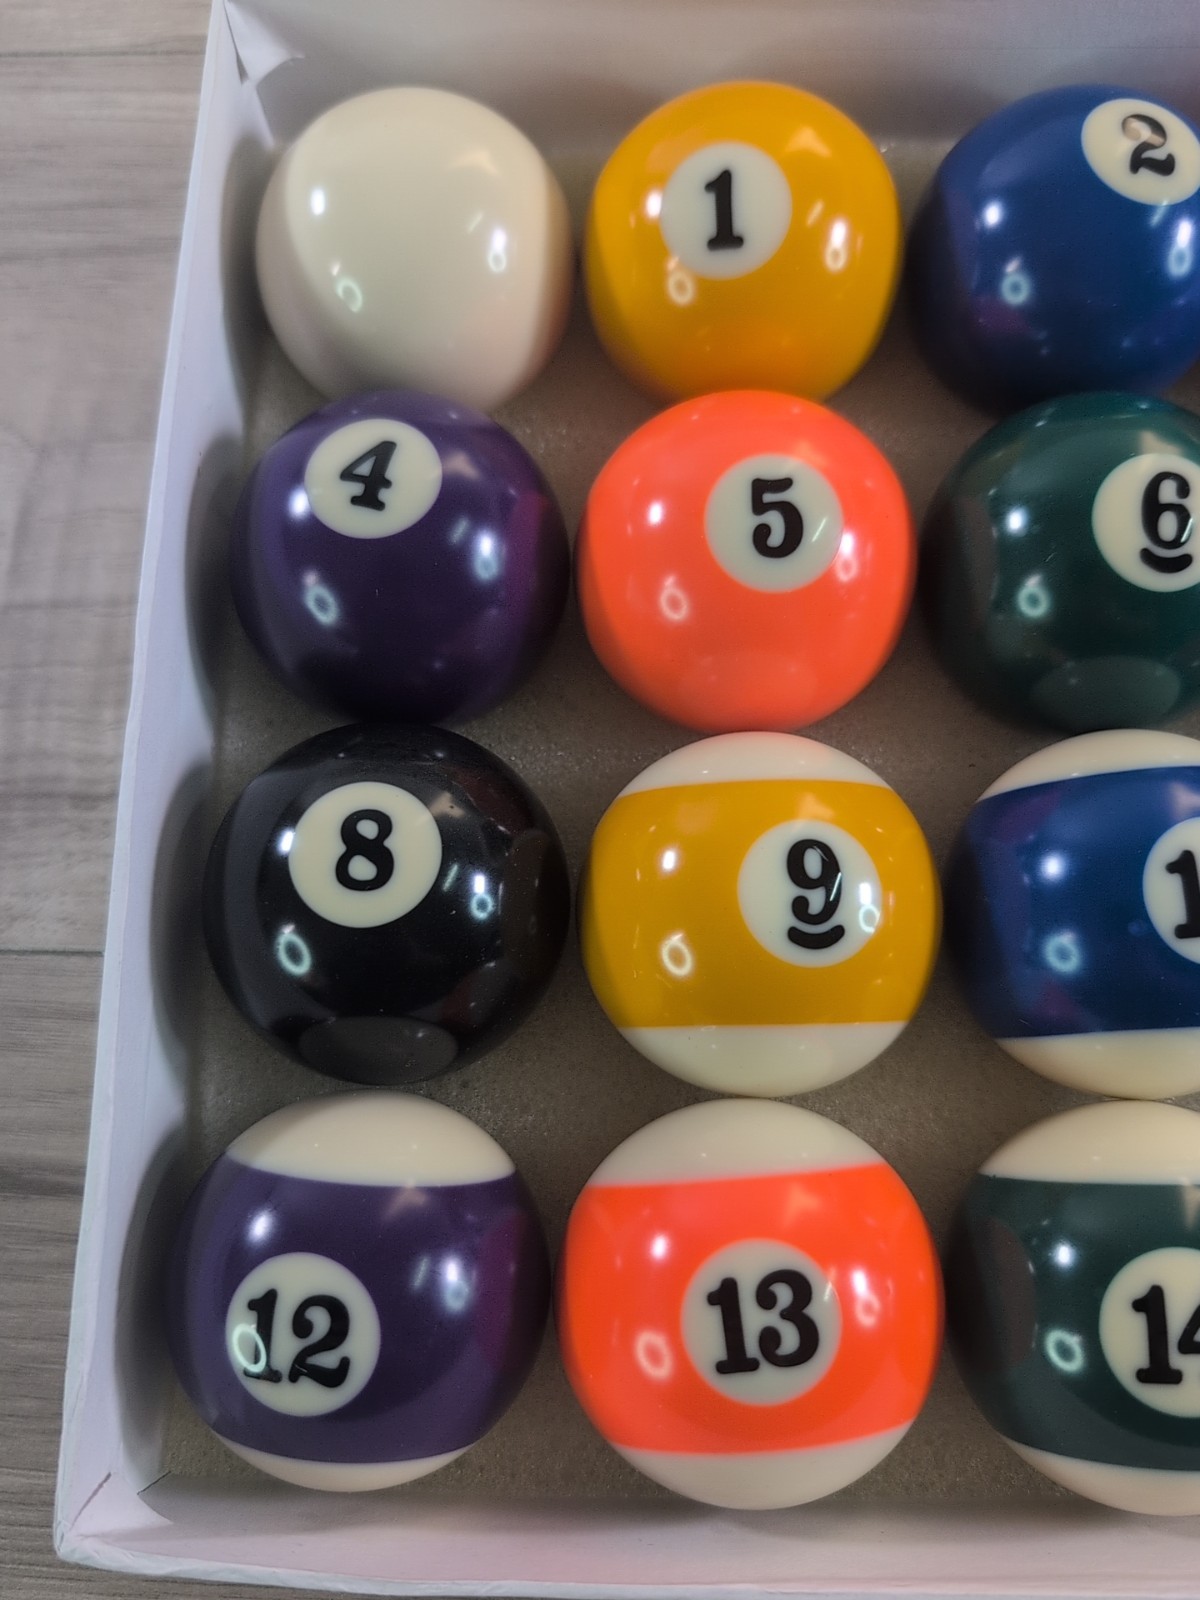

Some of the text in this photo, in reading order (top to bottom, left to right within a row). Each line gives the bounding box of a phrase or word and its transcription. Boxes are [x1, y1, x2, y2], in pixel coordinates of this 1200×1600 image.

[1122, 114, 1176, 177] 2
[705, 168, 745, 252] 1
[340, 440, 397, 512] 4
[751, 476, 805, 560] 5
[1140, 470, 1192, 551] 6
[335, 808, 396, 893] 8
[786, 838, 843, 926] 9
[245, 1288, 352, 1390] 12
[705, 1268, 821, 1378] 13
